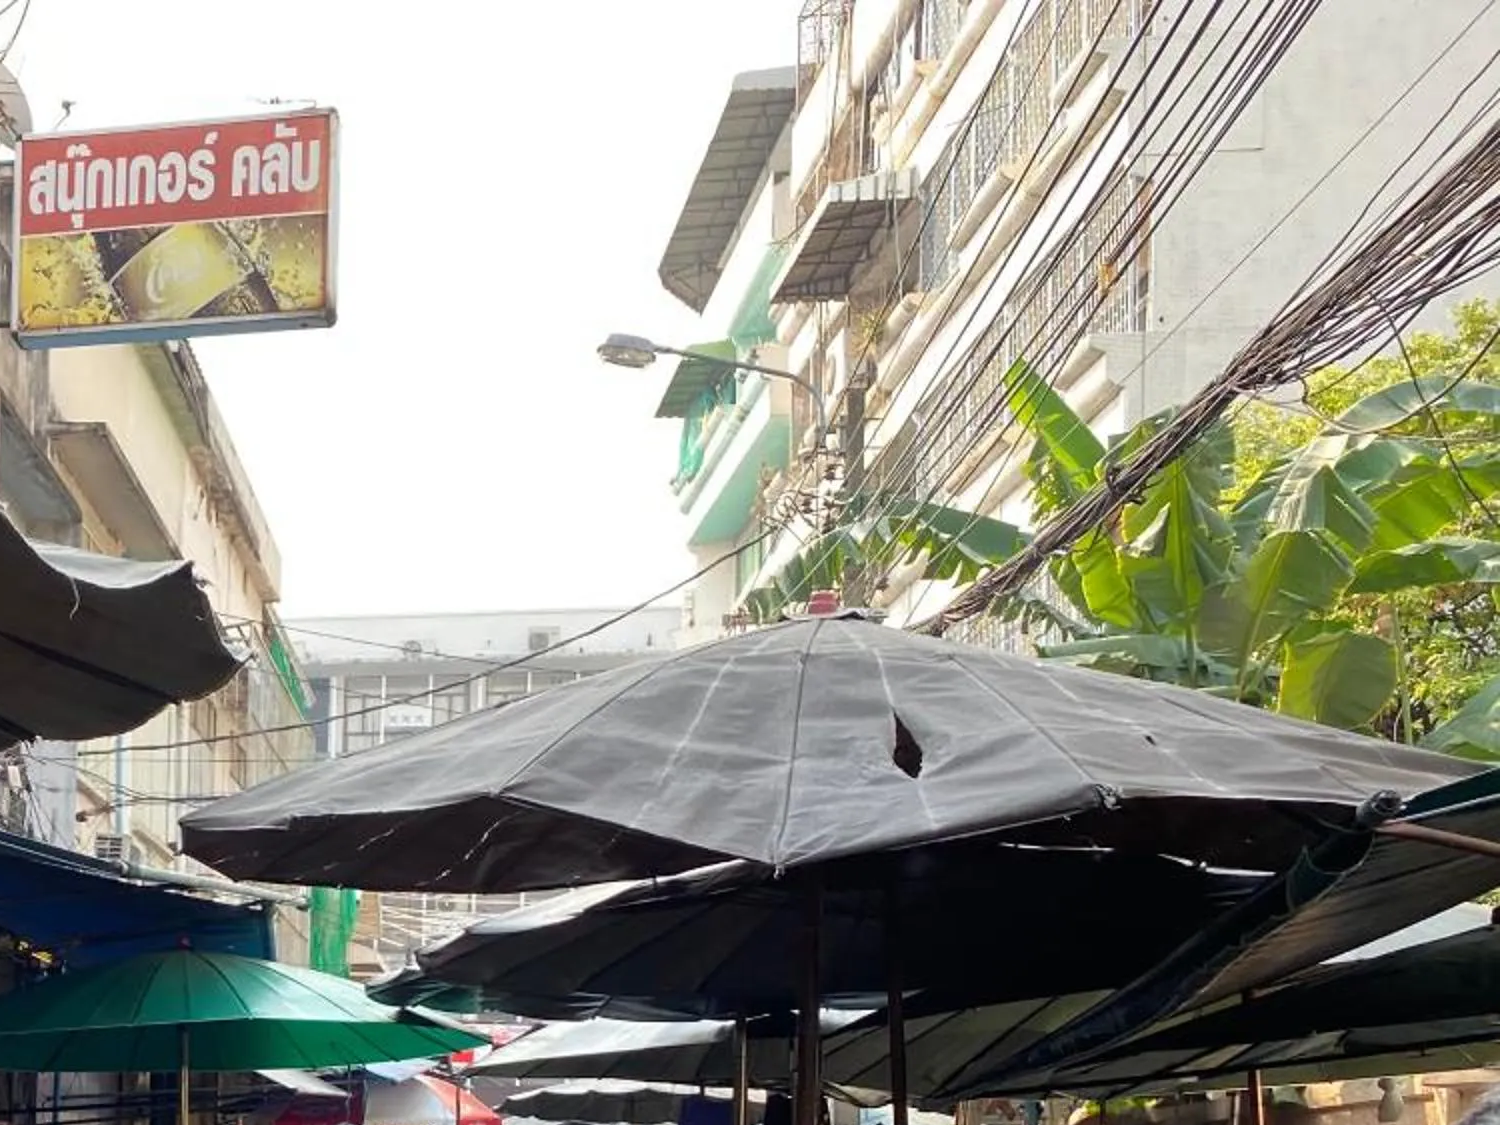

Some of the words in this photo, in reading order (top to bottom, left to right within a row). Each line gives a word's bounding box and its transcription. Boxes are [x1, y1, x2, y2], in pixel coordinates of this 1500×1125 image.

[28, 132, 219, 229] สนุ๊กเกอร์
[231, 122, 321, 198] คลับ
